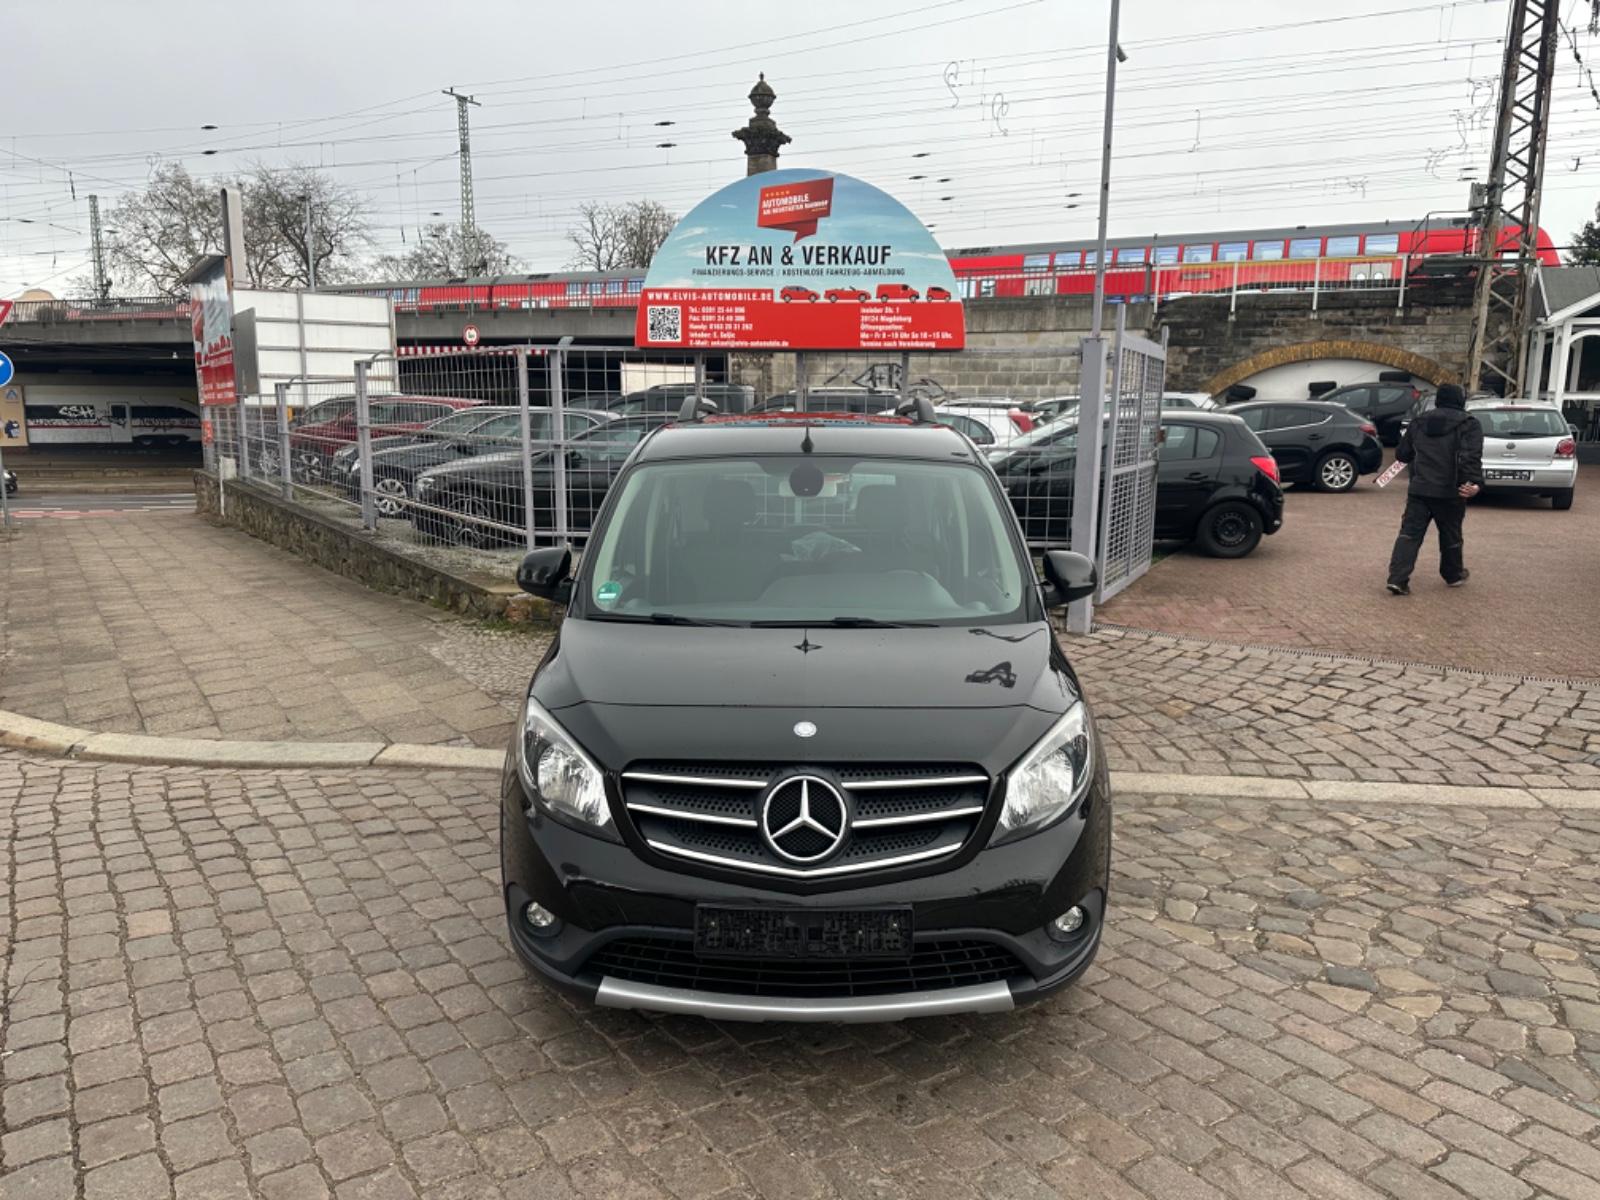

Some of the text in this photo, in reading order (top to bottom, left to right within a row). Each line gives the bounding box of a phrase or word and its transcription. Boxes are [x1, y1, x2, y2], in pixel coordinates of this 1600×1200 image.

[762, 193, 809, 208] AUTOMOBILE
[706, 246, 892, 265] KFZ AN & VERKAUF
[782, 268, 824, 276] KOSTENLOSE
[826, 268, 905, 276] FAHRZEUG-ABMELDUNG
[647, 292, 772, 301] WWW.ELVIS-AUTOMOBILE.DE
